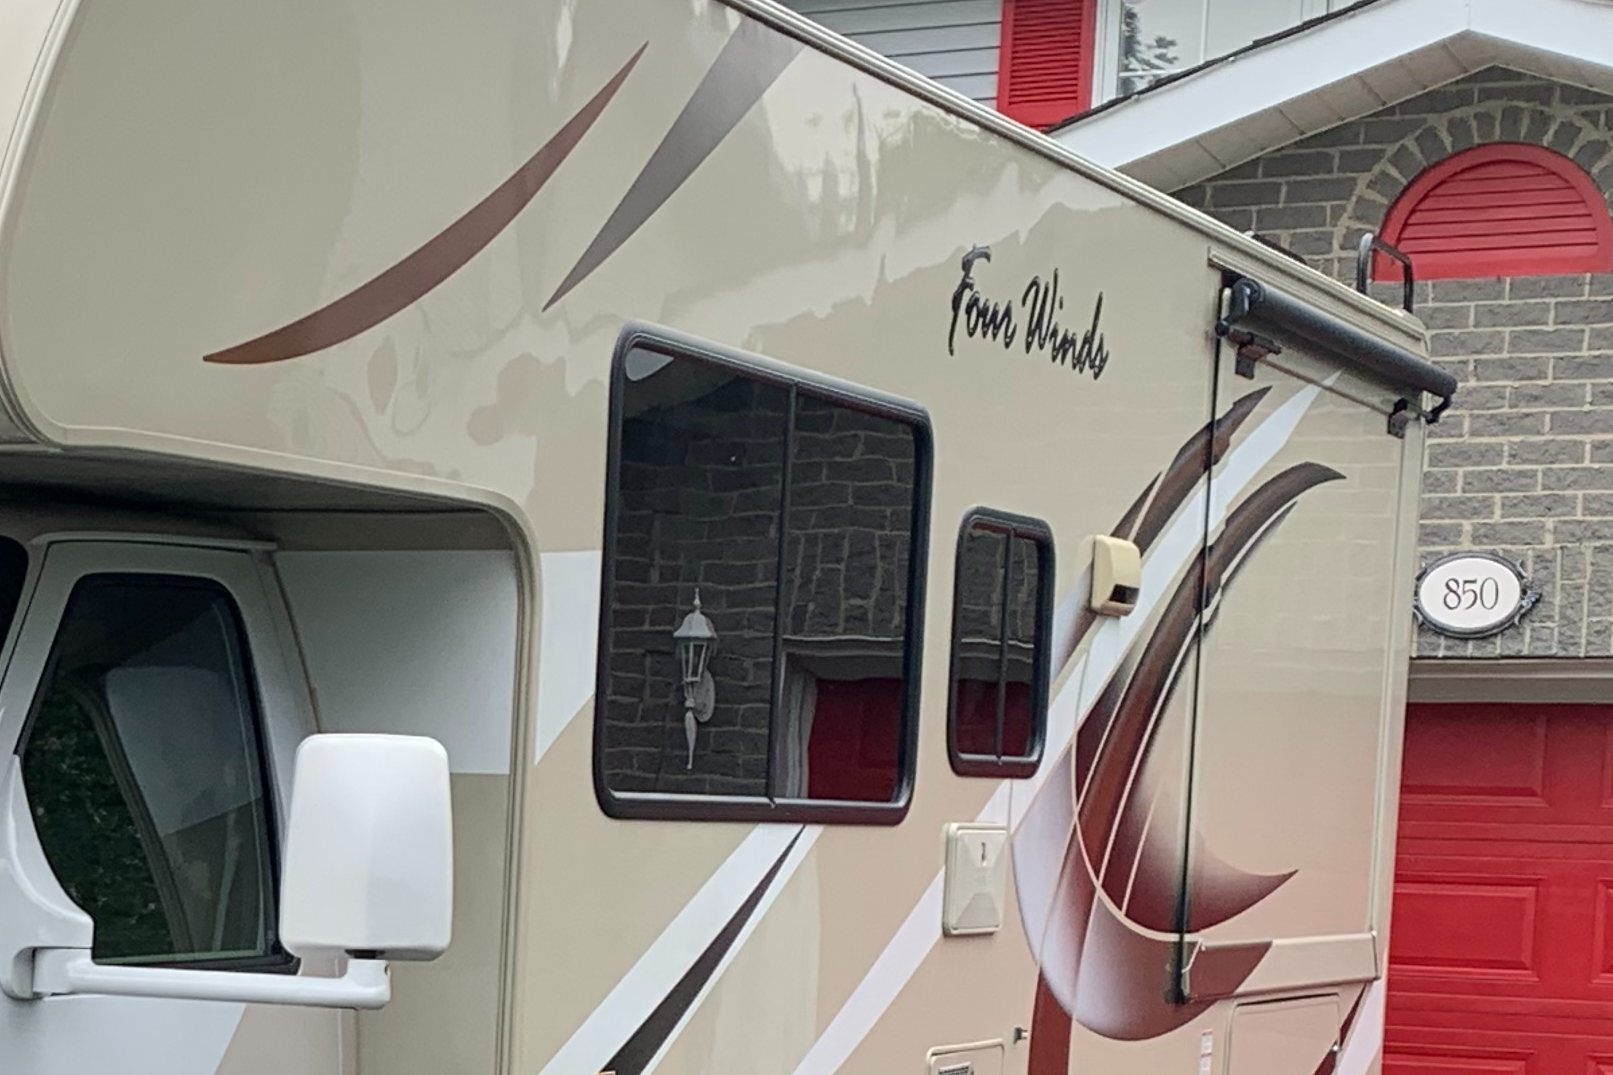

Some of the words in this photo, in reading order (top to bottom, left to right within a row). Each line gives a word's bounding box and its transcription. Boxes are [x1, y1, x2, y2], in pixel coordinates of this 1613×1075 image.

[948, 243, 1017, 357] Four
[1021, 267, 1109, 381] Winds
[1443, 577, 1499, 610] 850
